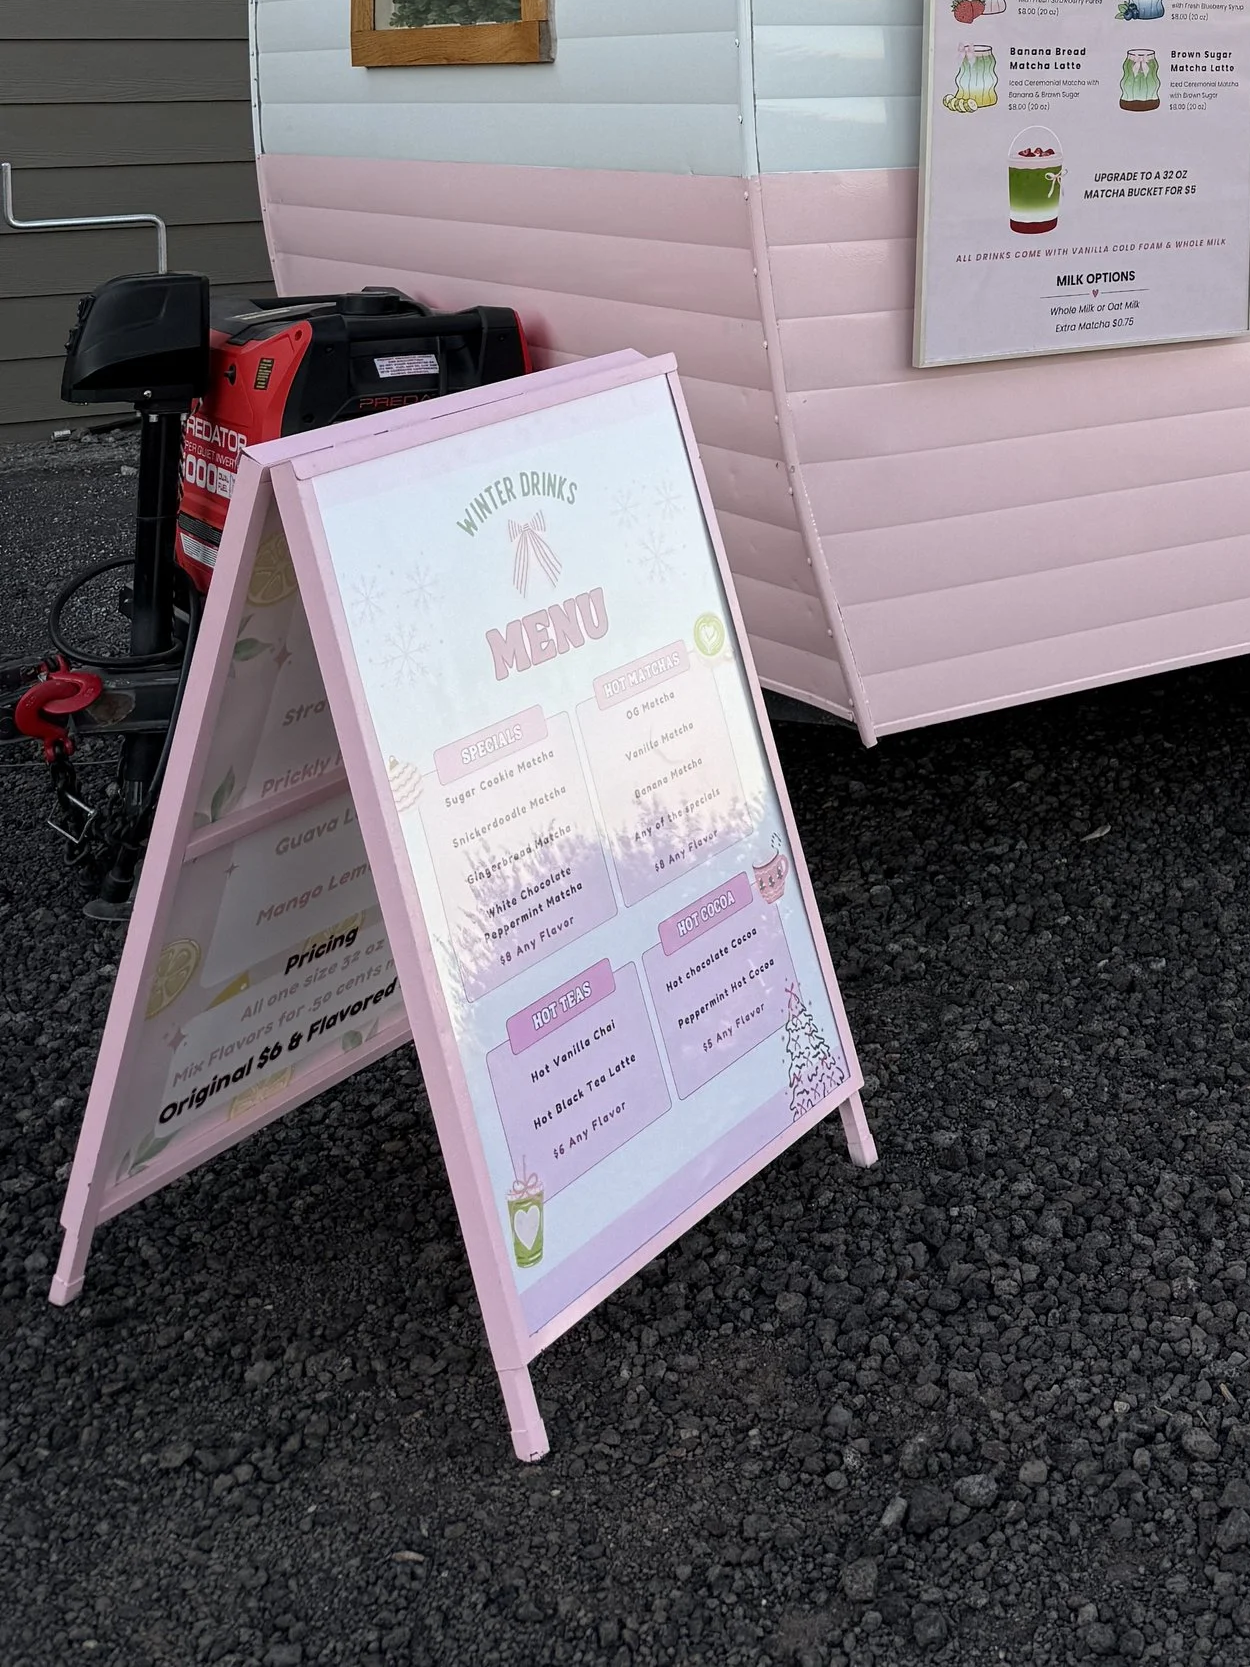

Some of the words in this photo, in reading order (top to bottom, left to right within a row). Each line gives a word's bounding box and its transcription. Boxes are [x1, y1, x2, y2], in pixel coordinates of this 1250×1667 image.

[1009, 61, 1050, 70] Matcha
[1054, 61, 1081, 70] Latte
[1010, 47, 1052, 56] Banana
[1055, 46, 1087, 56] Bread
[1170, 64, 1207, 72] Matcha
[1210, 64, 1235, 72] Latte
[1171, 50, 1201, 59] Brown
[1204, 50, 1232, 61] Sugar
[1083, 188, 1125, 199] MATCHA
[1127, 186, 1163, 197] BUCKET
[1165, 186, 1183, 195] FOR
[1185, 185, 1197, 195] $5
[1094, 171, 1138, 182] UPGRADE
[1140, 171, 1152, 181] TO
[1154, 171, 1161, 180] A
[1162, 170, 1174, 180] 32
[1175, 170, 1188, 179] OZ
[955, 254, 972, 263] ALL
[975, 251, 1011, 262] DRINKS
[1014, 249, 1041, 259] COME
[1045, 248, 1068, 257] WITH
[1071, 245, 1109, 255] VANILLA
[1112, 243, 1135, 253] COLD
[1138, 241, 1163, 251] FOAM
[1165, 241, 1171, 249] &
[1175, 239, 1204, 249] WHOLE
[1206, 238, 1226, 246] MILK
[1056, 274, 1083, 287] MILK
[1086, 270, 1135, 284] OPTIONS
[1050, 306, 1076, 316] Whole
[1079, 304, 1095, 314] Milk
[1097, 304, 1105, 312] or
[1107, 302, 1123, 311] Oat
[1124, 300, 1140, 310] Milk
[1055, 323, 1076, 333] Extra
[1078, 319, 1110, 331] Matcha
[1112, 317, 1134, 328] $0.75
[186, 415, 248, 455] REDATOR
[183, 453, 217, 494] 000
[456, 476, 517, 537] WINTER
[519, 471, 578, 505] DRINKS
[485, 586, 609, 681] MENU
[602, 676, 627, 699] HOT
[627, 652, 681, 687] MATCHAS
[282, 699, 328, 727] Stra
[626, 706, 640, 720] OG
[642, 691, 676, 714] Matcha
[460, 723, 523, 765] SPECIALS
[625, 739, 660, 762] Vanilla
[661, 721, 695, 745] Matcha
[261, 756, 332, 798] Prickly
[445, 787, 477, 808] Sugar
[479, 769, 515, 791] Cookie
[517, 749, 555, 774] Matcha
[634, 777, 669, 800] Banana
[670, 757, 704, 781] Matcha
[275, 814, 340, 856] Guava
[452, 805, 527, 849] Snickerdoodle
[529, 785, 567, 810] Matcha
[635, 827, 652, 842] Any
[655, 817, 666, 831] of
[667, 809, 683, 823] the
[685, 788, 721, 814] specials
[467, 844, 533, 885] Gingerbread
[535, 824, 573, 850] Matcha
[654, 859, 666, 873] $8
[669, 850, 687, 867] Any
[688, 830, 719, 852] Flavor
[255, 883, 323, 926] Mango
[327, 862, 371, 892] Lem
[484, 903, 544, 944] Peppermint
[546, 881, 583, 908] Matcha
[486, 897, 518, 919] White
[520, 866, 572, 901] Chocolate
[676, 911, 700, 938] HOT
[700, 890, 736, 922] COCOA
[284, 926, 359, 977] Pricing
[499, 951, 513, 966] $8
[516, 938, 537, 956] Any
[539, 916, 575, 942] Flavor
[666, 975, 684, 993] Hot
[685, 947, 729, 979] chocolate
[730, 927, 757, 949] Cocoa
[240, 997, 264, 1022] All
[267, 982, 300, 1007] one
[303, 962, 338, 988] size
[340, 950, 362, 971] 32
[364, 938, 386, 955] oz
[677, 988, 729, 1029] Peppermint
[730, 976, 747, 993] Hot
[748, 958, 775, 980] Cocoa
[172, 1059, 205, 1088] Mix
[207, 1021, 275, 1067] Flavors
[277, 1004, 306, 1028] for
[335, 964, 382, 997] cents
[531, 1001, 558, 1031] HOT
[558, 980, 593, 1013] TEAS
[702, 1039, 713, 1053] $5
[716, 1026, 733, 1043] Any
[735, 1002, 766, 1029] Flavor
[158, 1055, 255, 1124] Original
[256, 1040, 284, 1071] $6
[287, 1030, 305, 1053] &
[306, 977, 399, 1043] Flavored
[530, 1064, 551, 1083] Hot
[552, 1038, 591, 1067] Vanilla
[593, 1019, 616, 1040] Chai
[533, 1110, 553, 1130] Hot
[555, 1089, 585, 1114] Black
[586, 1074, 607, 1092] Tea
[608, 1053, 637, 1078] Latte
[553, 1144, 565, 1159] $6
[569, 1129, 589, 1149] Any
[591, 1101, 627, 1131] Flavor
